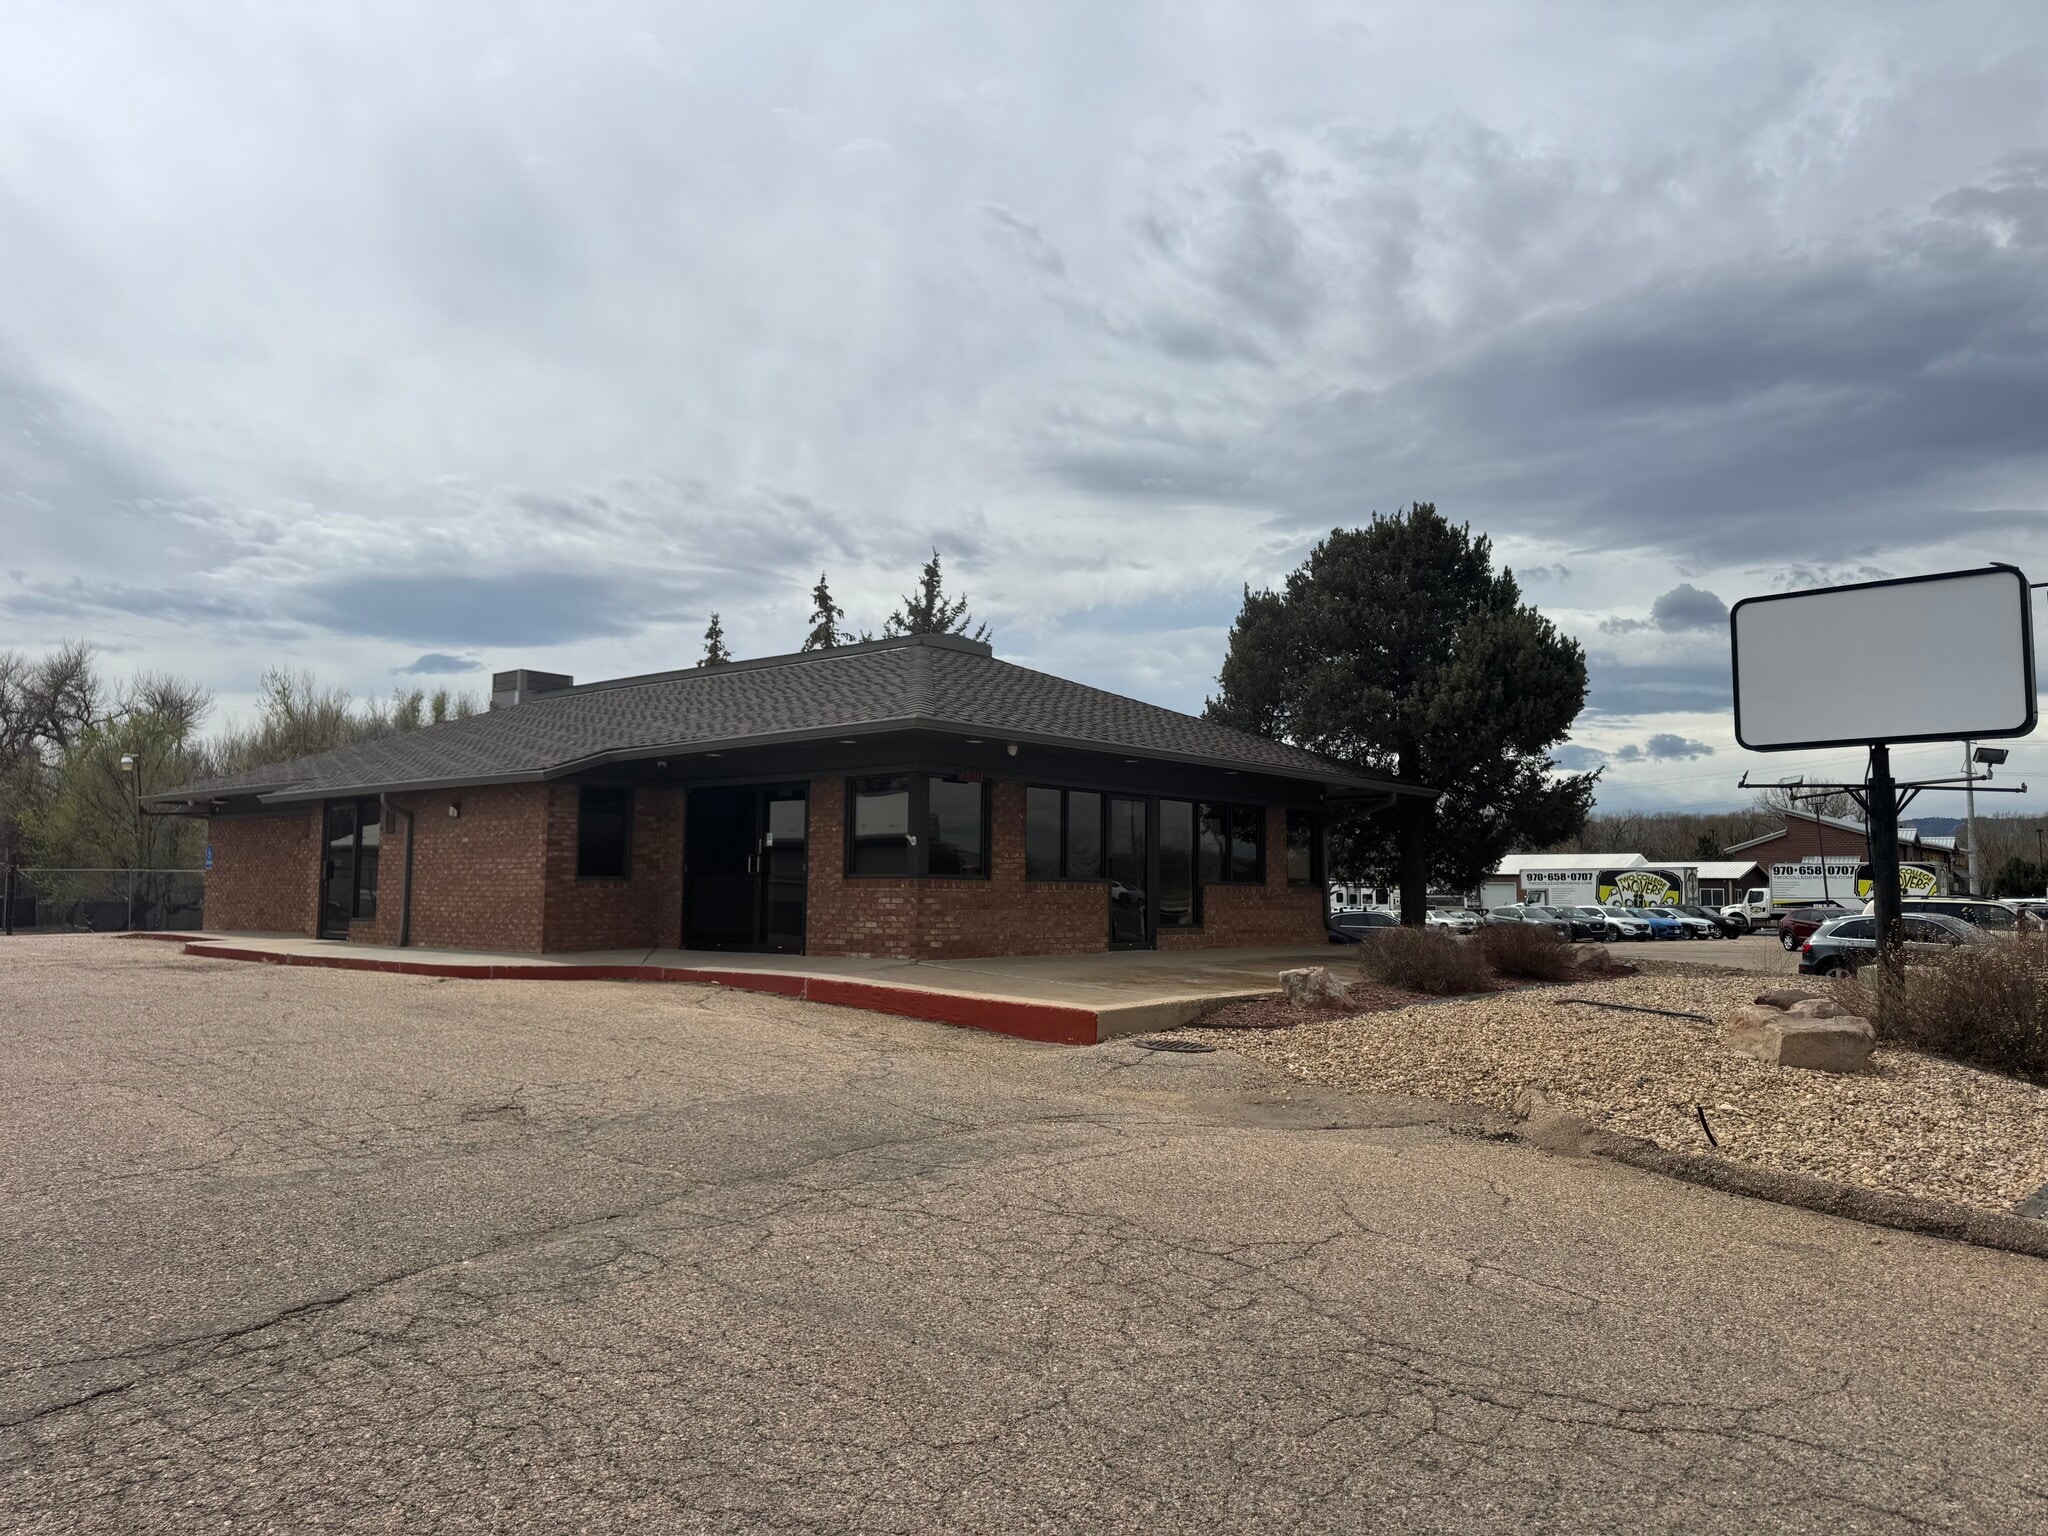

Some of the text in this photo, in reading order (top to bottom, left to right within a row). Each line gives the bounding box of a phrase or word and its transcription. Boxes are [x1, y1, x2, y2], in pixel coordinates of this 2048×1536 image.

[1618, 874, 1666, 888] TWO COLLEGE
[1899, 874, 1929, 889] OVERS
[1900, 868, 1934, 883] COLLEGE
[1622, 880, 1661, 896] MOVERS
